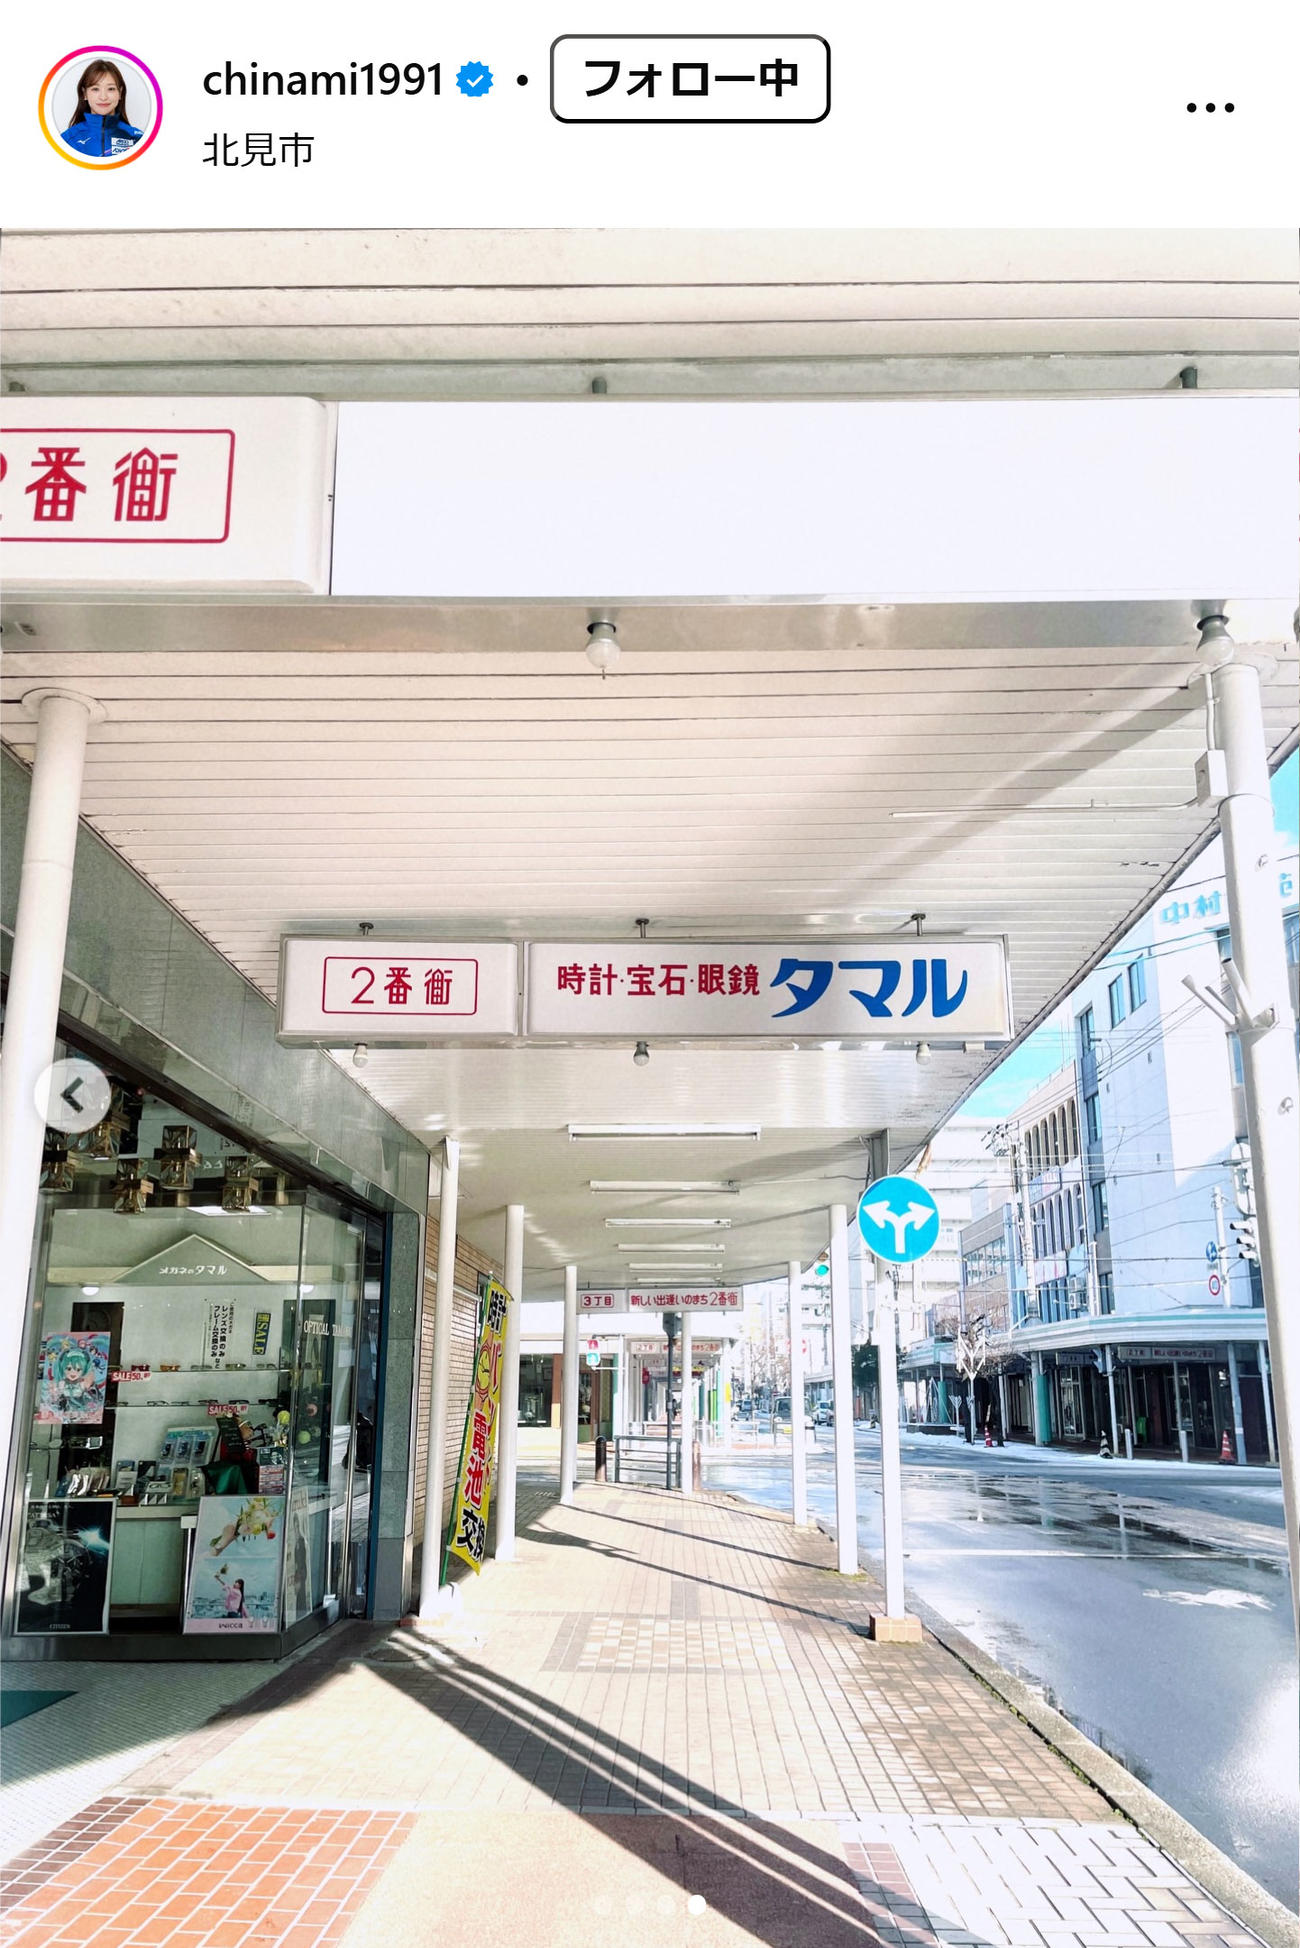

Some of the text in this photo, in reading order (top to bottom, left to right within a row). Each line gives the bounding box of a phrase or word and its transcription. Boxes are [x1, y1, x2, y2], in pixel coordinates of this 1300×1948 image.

[770, 958, 968, 1018] タマル
[159, 1264, 228, 1276] メガネのタマル
[583, 1296, 612, 1307] 3丁目
[303, 1319, 330, 1336] OPTICAL
[464, 1410, 491, 1511] 電池
